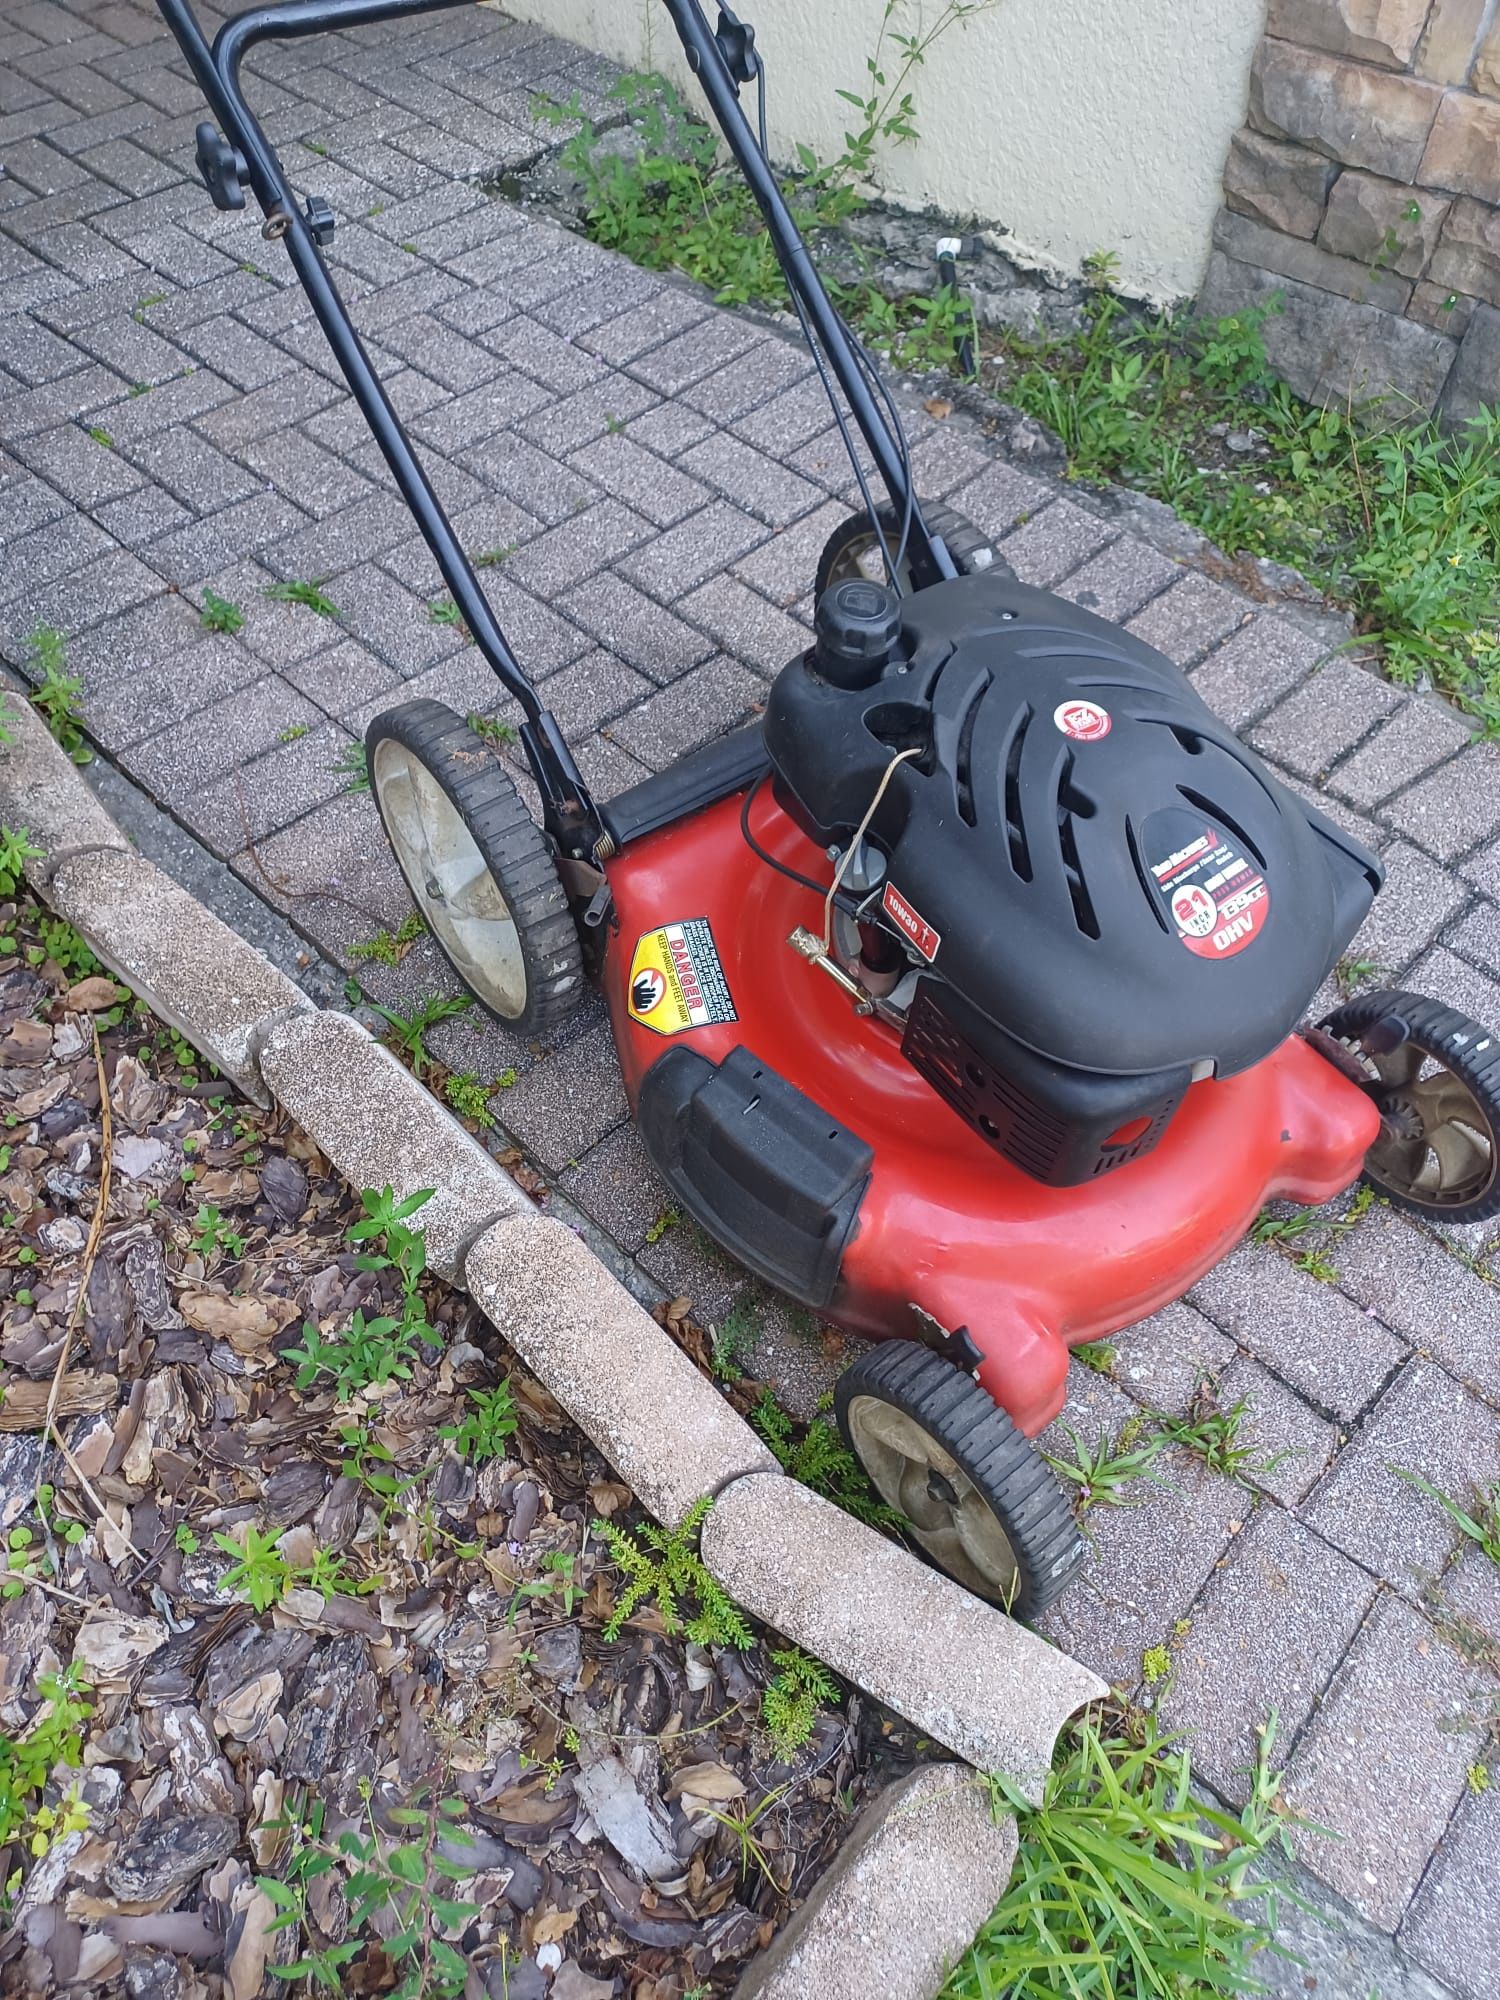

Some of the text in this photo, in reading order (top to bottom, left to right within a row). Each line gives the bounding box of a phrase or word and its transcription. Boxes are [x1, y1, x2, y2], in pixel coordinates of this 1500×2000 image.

[889, 894, 918, 934] 10W30
[1174, 889, 1208, 922] 21
[1189, 910, 1211, 928] INCH
[1220, 885, 1266, 921] 139cc
[1213, 911, 1255, 951] OHV
[657, 933, 690, 1023] KEEP HANDS and FEET AWAY
[670, 938, 703, 1010] DANGER
